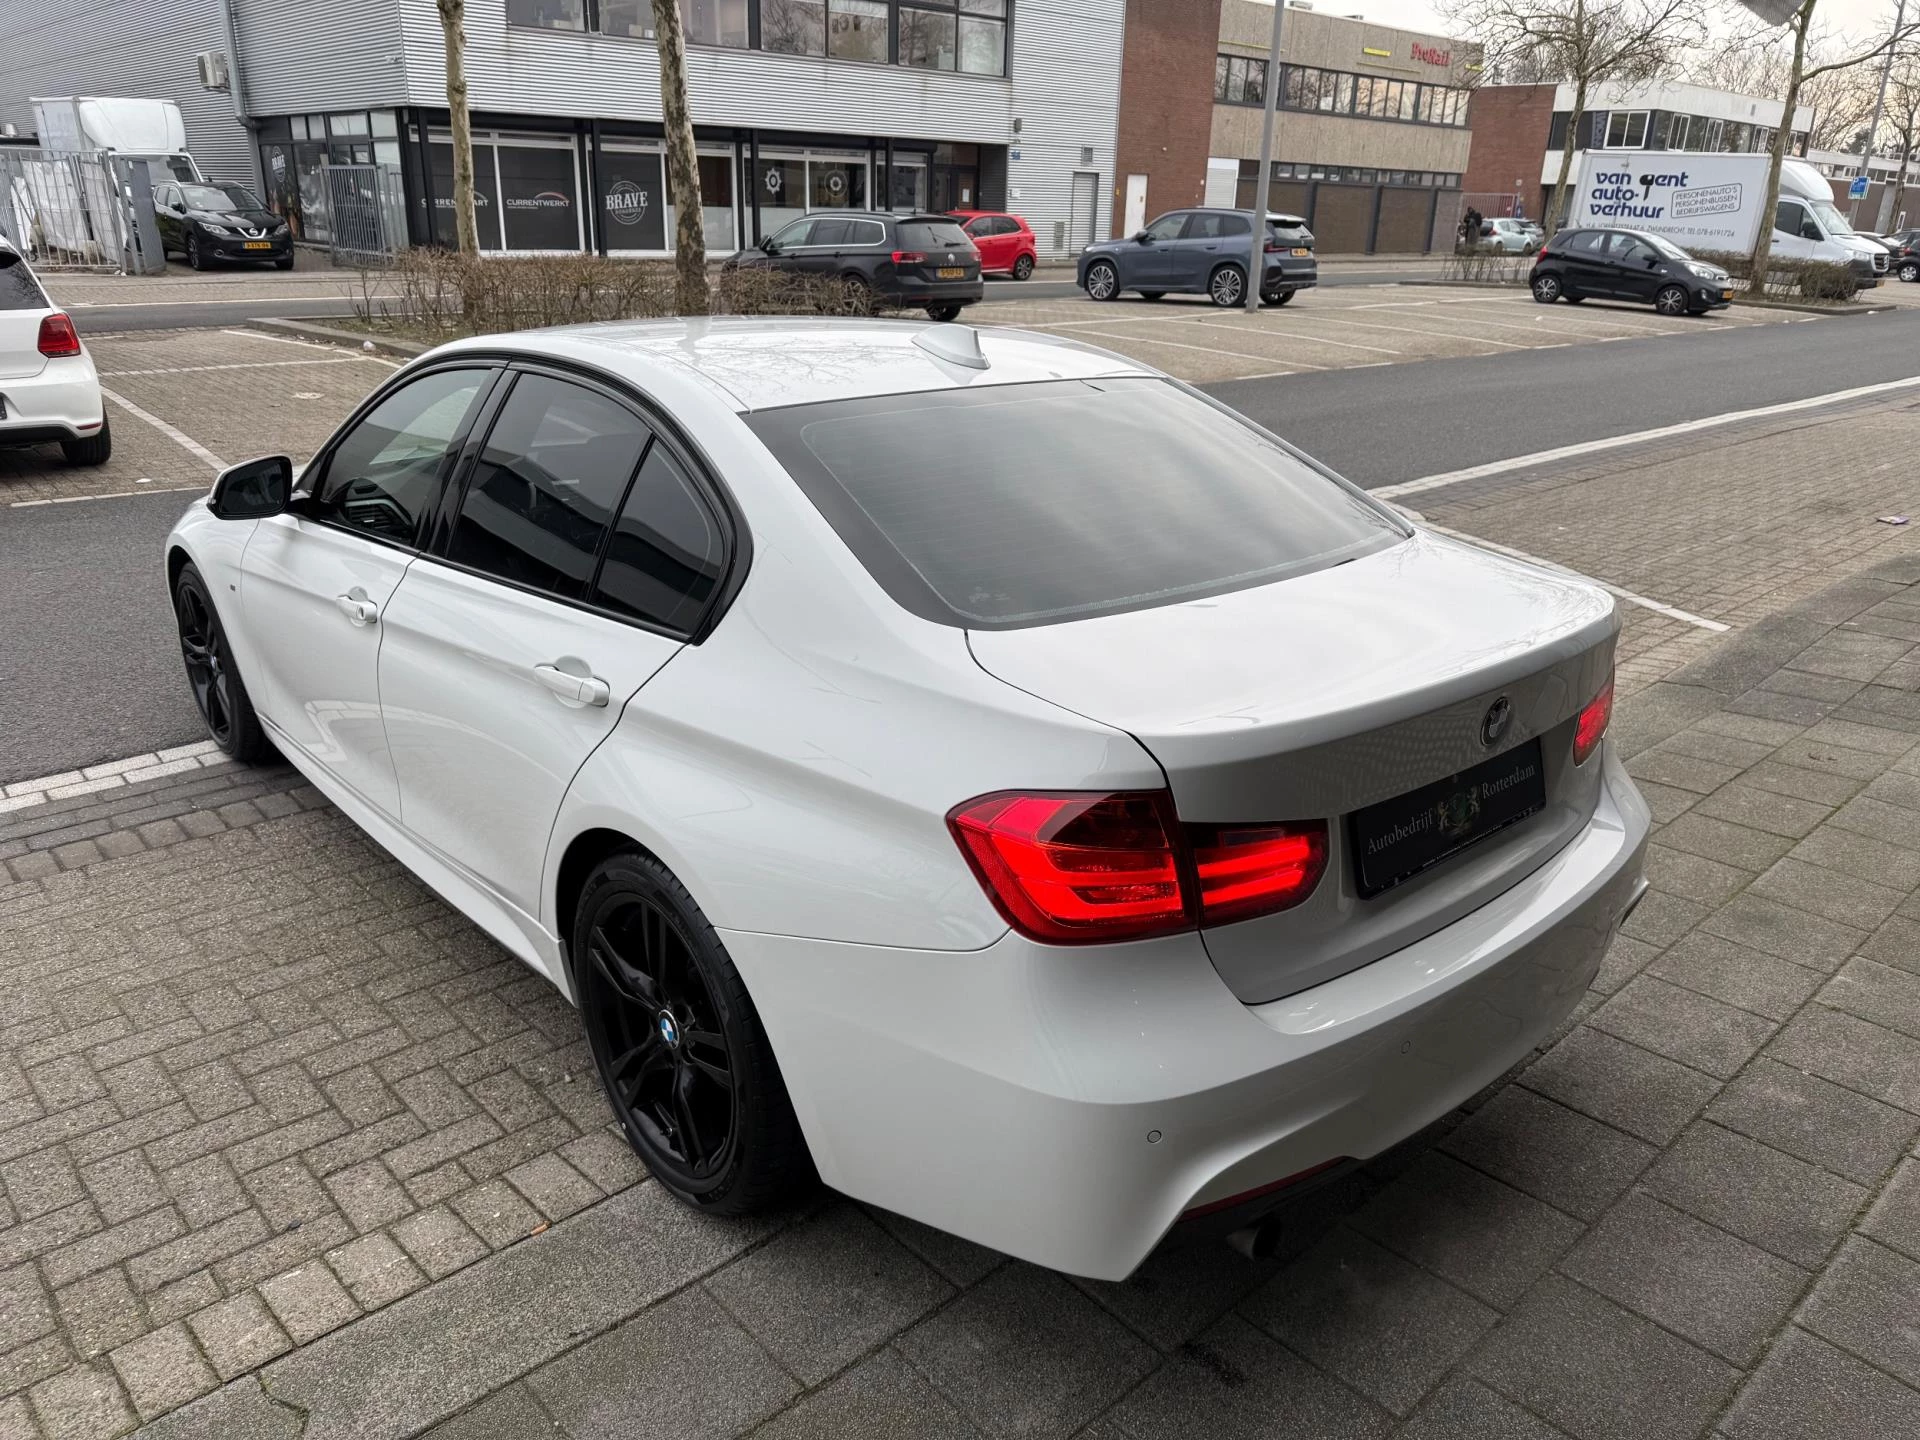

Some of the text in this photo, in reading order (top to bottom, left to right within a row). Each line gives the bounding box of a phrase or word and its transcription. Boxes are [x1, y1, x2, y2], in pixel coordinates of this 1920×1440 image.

[1596, 172, 1631, 185] van
[1591, 186, 1639, 201] auto-
[1676, 186, 1738, 199] PERSONENAUTO'S
[506, 198, 570, 207] CURRENTWERKT
[605, 191, 648, 210] BRAVE
[1675, 194, 1738, 207] PERSONENBUSSEN
[1590, 202, 1665, 219] verhuur
[1482, 764, 1536, 800] Rotterdam
[1367, 808, 1434, 855] Autobedrijf
